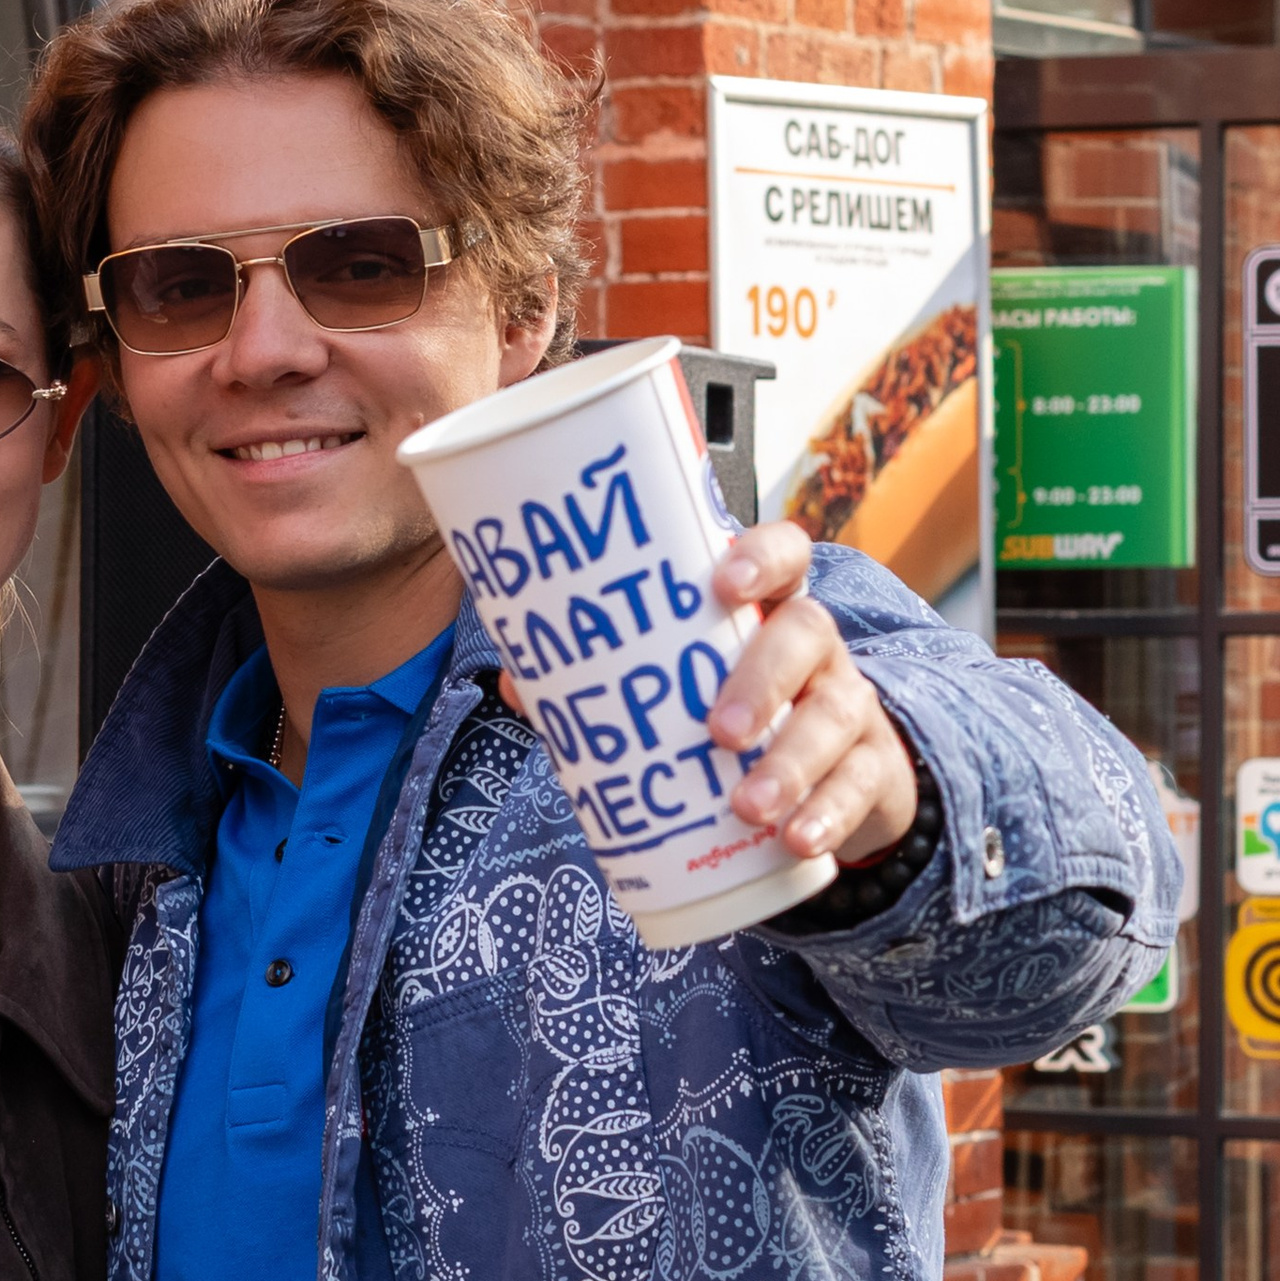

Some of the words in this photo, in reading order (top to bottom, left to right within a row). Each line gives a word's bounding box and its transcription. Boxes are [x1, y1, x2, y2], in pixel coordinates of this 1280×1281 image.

[785, 120, 905, 168] САБ-ДОГ
[765, 186, 784, 223] С
[792, 188, 933, 234] РЕЛИШЕМ
[747, 284, 818, 339] 190
[451, 444, 651, 601] АВАЙ
[1000, 532, 1124, 560] SUBWAY
[494, 560, 703, 681] ЕЛАТЬ
[536, 641, 731, 770] ОБРО
